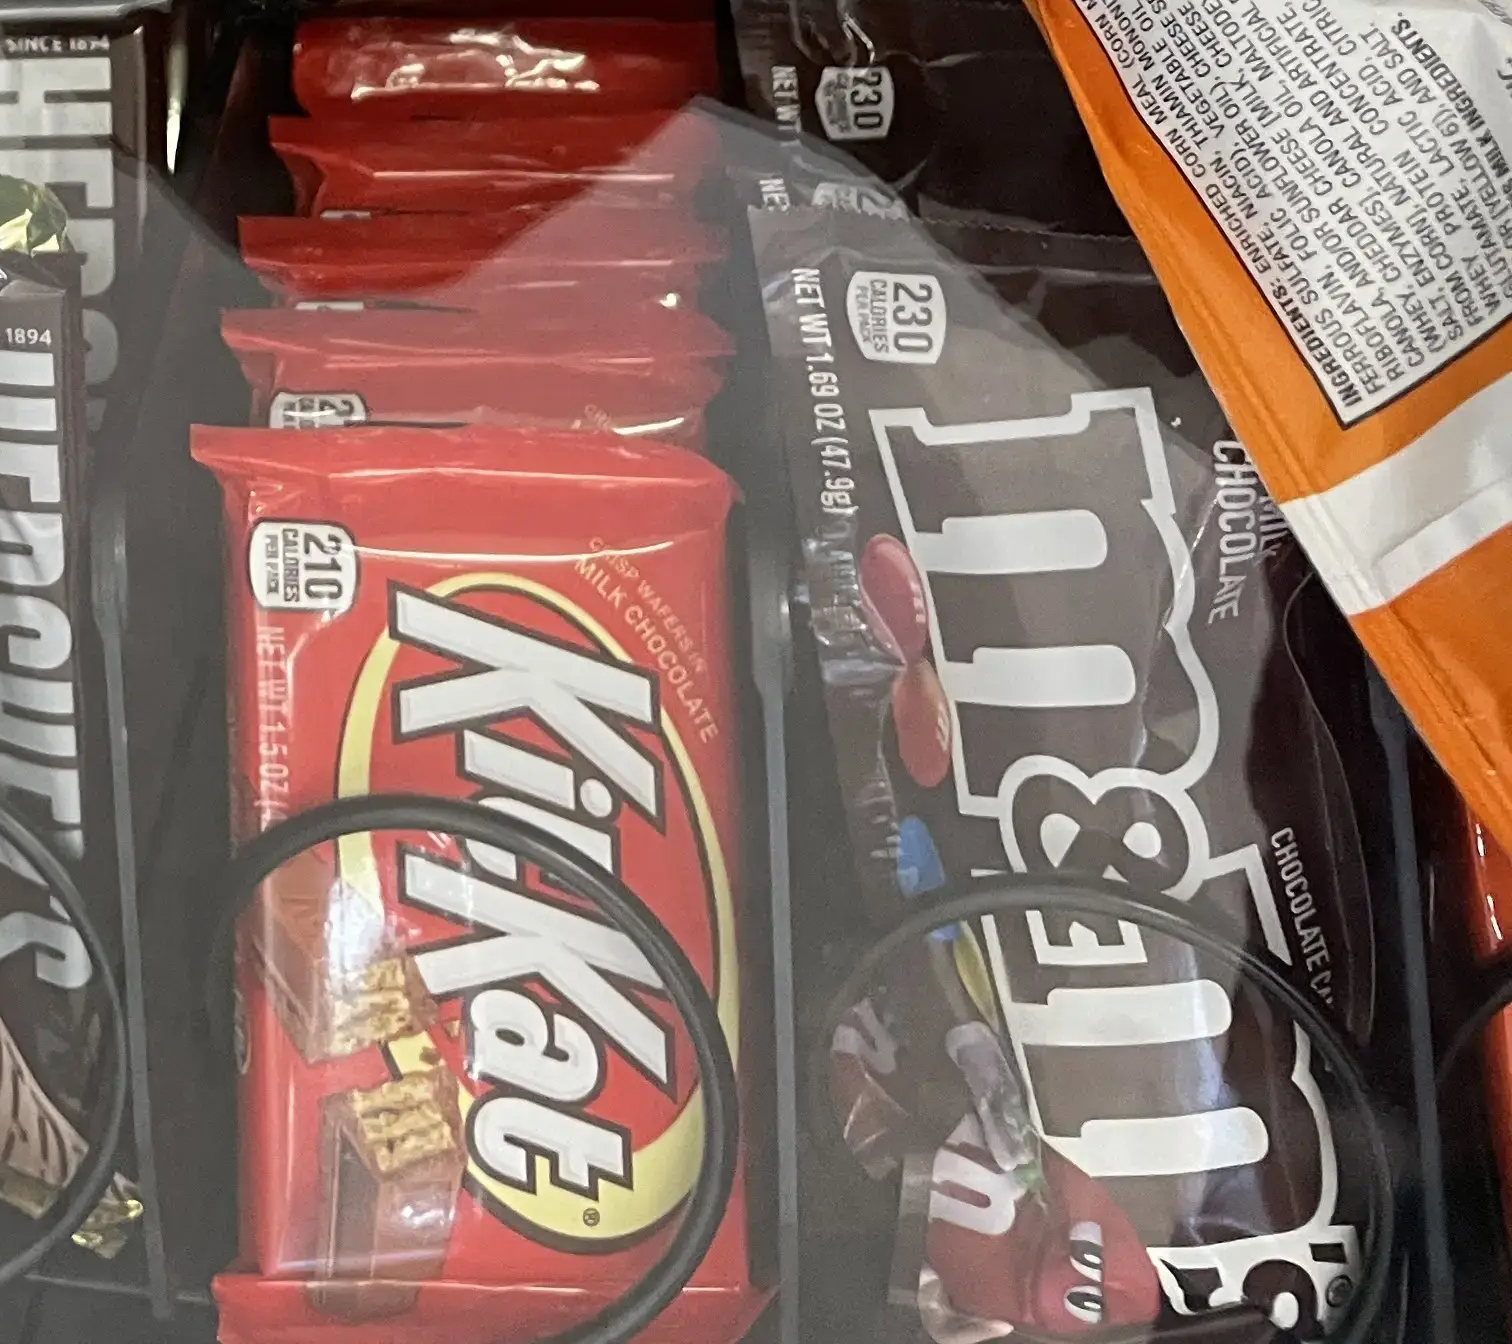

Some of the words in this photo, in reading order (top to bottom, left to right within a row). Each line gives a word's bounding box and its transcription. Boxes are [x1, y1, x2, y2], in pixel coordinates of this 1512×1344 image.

[1093, 12, 1137, 71] (CORN
[1159, 11, 1213, 79] CHEESE
[1176, 0, 1234, 69] CHEESE
[1272, 0, 1391, 139] CONCENTRATE,
[1356, 20, 1407, 72] SALT.
[1126, 72, 1168, 125] MEAL
[1150, 36, 1228, 138] VEGETABLE
[1265, 77, 1306, 120] OIL,
[1353, 54, 1403, 110] ACID,
[1384, 10, 1486, 132] INGREDIENTS.
[1394, 64, 1437, 109] AND
[1150, 72, 1211, 150] THIAMIN
[1306, 87, 1349, 130] AND
[1395, 107, 1455, 178] LACTIC
[1164, 127, 1207, 180] CORN
[1204, 149, 1258, 220] NIACIN,
[1232, 117, 1322, 225] SUNFLOWER
[1270, 127, 1335, 198] CHEESE
[1295, 115, 1363, 191] CANOLA
[1338, 124, 1412, 208] NATURAL
[1473, 127, 1512, 178] MILK
[1202, 180, 1272, 275] ENRICHED
[1392, 148, 1462, 236] PROTEIN
[1267, 204, 1317, 263] FOLIC
[1311, 220, 1375, 292] AND/OR
[1326, 195, 1403, 285] CHEDDAR
[791, 265, 821, 307] NET
[868, 278, 892, 353] CALORIES
[889, 279, 936, 355] 230
[1442, 269, 1486, 328] FROM
[1459, 249, 1504, 314] WHEY
[6, 327, 53, 347] 1894
[798, 311, 828, 345] WT
[1265, 276, 1364, 409] INGREDIENTS:
[1311, 304, 1385, 396] FERROUS
[1365, 286, 1427, 369] CANOLA,
[804, 351, 837, 396] 1.69
[812, 399, 843, 433] OZ
[809, 432, 858, 518] (47.9g)
[282, 528, 299, 602] CALORIES
[303, 532, 342, 600] 210
[1207, 437, 1253, 626] CHOCOLATE
[255, 626, 285, 671] NET
[571, 554, 629, 609] MILK
[620, 602, 721, 745] CHOCOLATE
[634, 579, 696, 656] WAFERS
[257, 678, 285, 712] WT
[259, 762, 288, 793] OZ
[1270, 826, 1327, 979] CHOCOLATE
